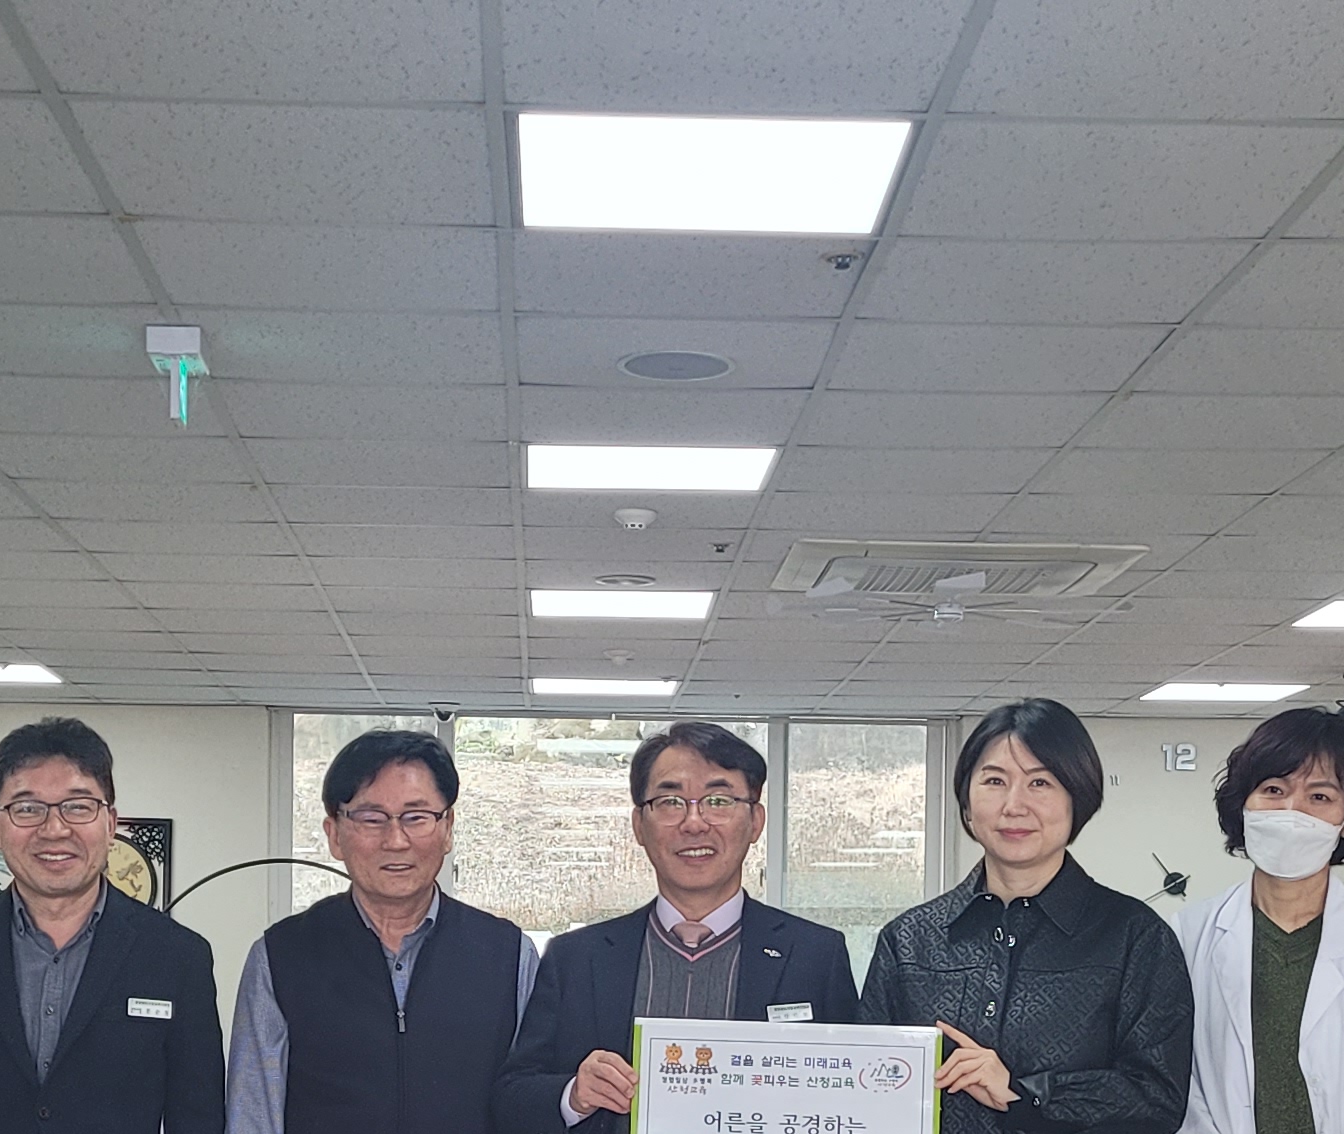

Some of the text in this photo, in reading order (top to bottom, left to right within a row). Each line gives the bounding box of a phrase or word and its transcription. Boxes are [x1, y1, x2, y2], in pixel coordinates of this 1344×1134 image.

[1162, 743, 1197, 771] 12
[1110, 775, 1120, 786] 11
[761, 1055, 797, 1068] 살리는
[804, 1056, 852, 1070] 미래교육
[721, 1073, 855, 1089] 함께 꽃피우는 산청교육
[703, 1111, 768, 1134] 어른을
